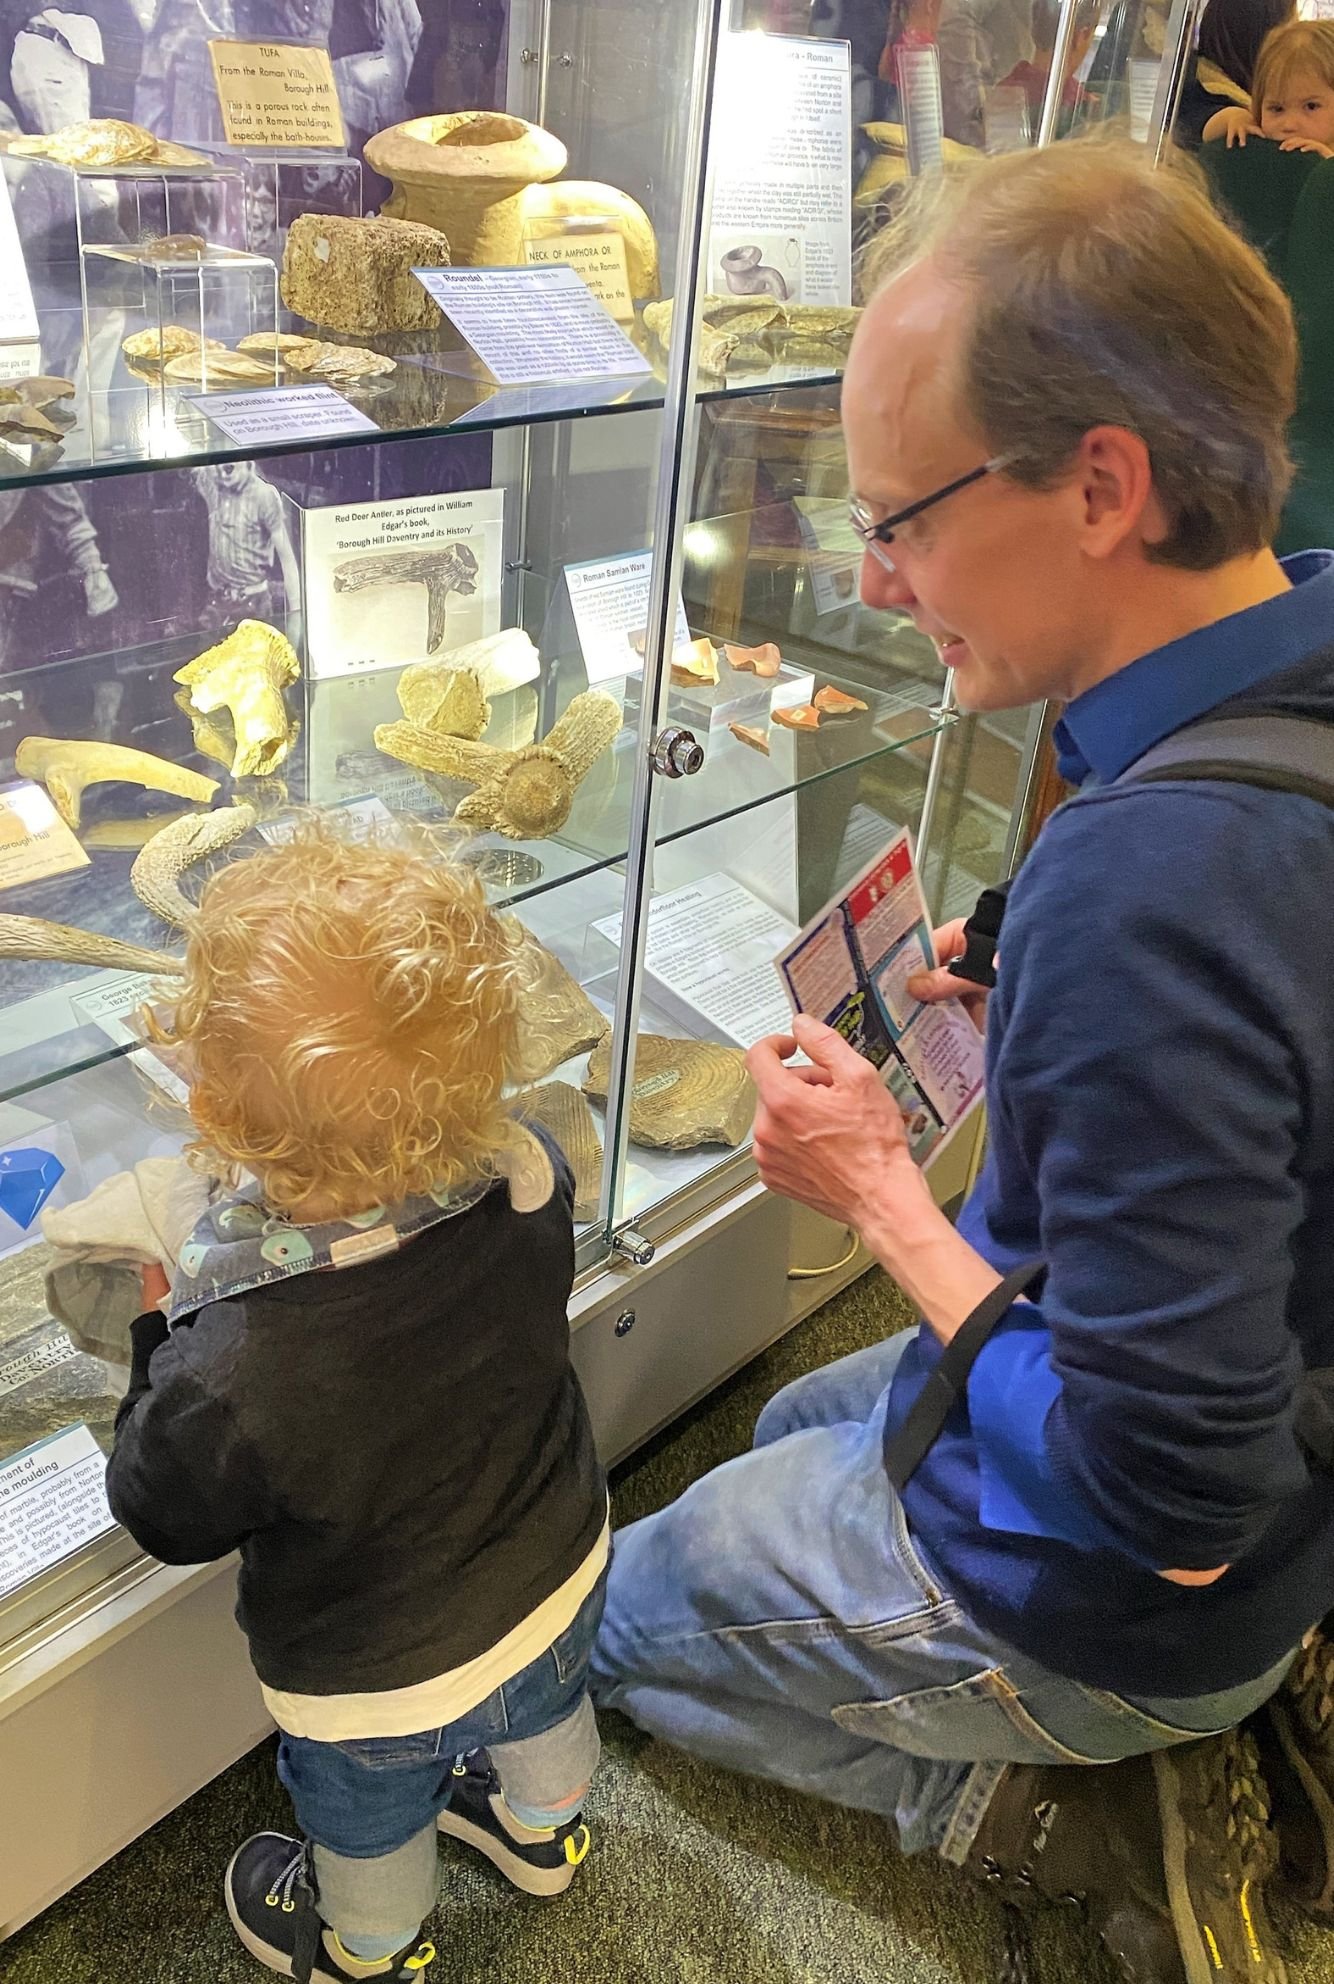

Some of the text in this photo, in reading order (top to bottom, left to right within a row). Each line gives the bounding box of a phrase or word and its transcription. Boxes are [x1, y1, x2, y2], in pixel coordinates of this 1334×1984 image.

[260, 48, 280, 57] TUFA
[807, 52, 833, 62] Roman
[220, 65, 240, 75] From
[243, 66, 255, 75] the
[259, 67, 285, 78] Roman
[284, 83, 329, 95] Borough Hill
[228, 100, 242, 110] This
[246, 102, 251, 110] is
[264, 103, 289, 113] porous
[292, 102, 307, 111] rock
[311, 102, 330, 112] often
[230, 115, 252, 125] found
[256, 116, 263, 125] in
[267, 116, 293, 125] Roman
[233, 131, 268, 142] especially
[271, 132, 283, 141] the
[529, 246, 611, 261] NECK OF AMPHORA OR
[589, 263, 600, 272] the
[600, 262, 620, 271] Roman
[443, 273, 483, 282] Roundel
[616, 289, 625, 298] the
[225, 392, 338, 408] Neolithic worked flint
[224, 416, 249, 427] Used
[335, 514, 350, 523] Red
[352, 513, 369, 521] Deer
[371, 511, 394, 519] Antler,
[406, 504, 435, 515] pictured
[446, 500, 473, 511] William
[382, 518, 430, 531] Edgar's book,
[372, 536, 385, 545] Hill
[387, 533, 420, 543] Daventry
[421, 530, 435, 539] and
[436, 528, 445, 537] its
[583, 572, 606, 583] Roman
[607, 567, 630, 577] Samian
[33, 830, 50, 841] Hill
[102, 987, 132, 1000] George
[24, 1457, 35, 1469] of
[11, 1461, 59, 1491] moulding
[0, 1511, 8, 1520] of
[40, 1476, 72, 1498] probably
[73, 1466, 92, 1479] from
[8, 1470, 105, 1528] and possibly from Norton
[16, 1528, 24, 1536] is
[57, 1487, 97, 1513] (alongside
[21, 1535, 30, 1545] of
[32, 1512, 71, 1539] hypocaust
[72, 1502, 90, 1515] tiles
[91, 1496, 100, 1505] to
[17, 1507, 102, 1559] in Edgar's book on
[39, 1543, 62, 1559] made
[63, 1535, 72, 1545] at
[72, 1528, 86, 1539] the
[87, 1519, 102, 1530] site
[103, 1511, 112, 1521] of
